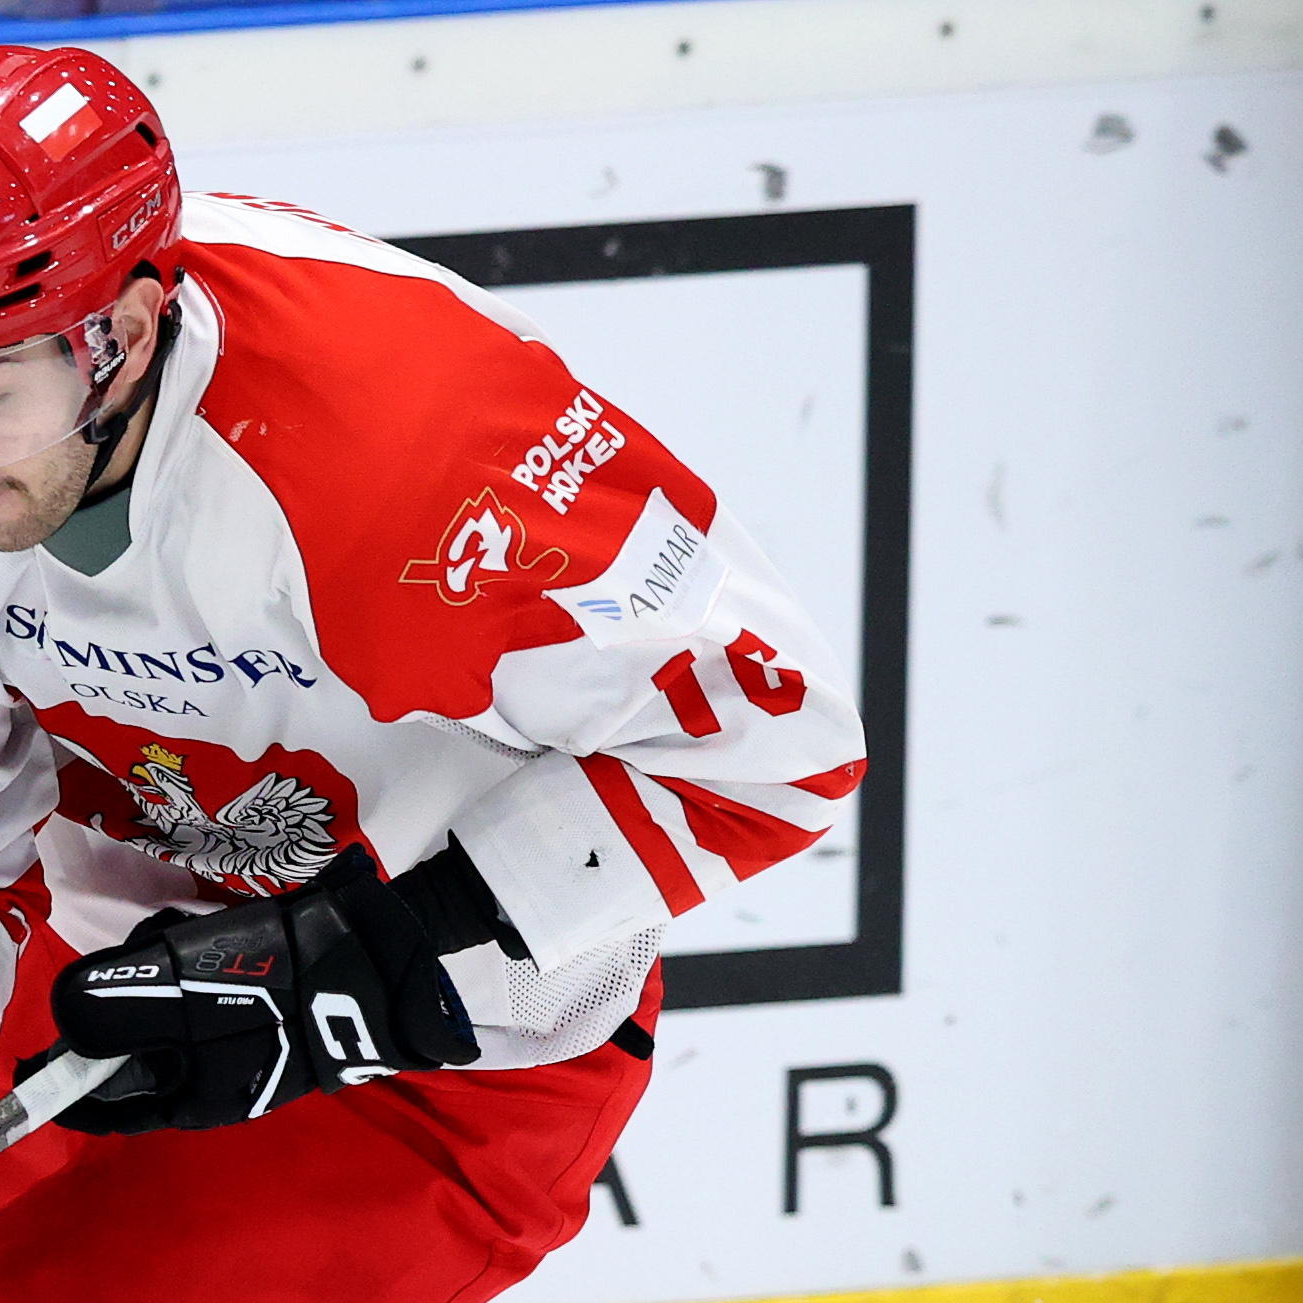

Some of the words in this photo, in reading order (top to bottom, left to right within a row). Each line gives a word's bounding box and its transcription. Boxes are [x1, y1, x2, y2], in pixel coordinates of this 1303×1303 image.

[112, 188, 162, 249] CCM
[510, 388, 605, 492] POLSKI
[541, 420, 626, 516] HOKEJ
[629, 524, 699, 618] ANMAR
[69, 683, 211, 718] OLSKA
[87, 964, 161, 982] CCM
